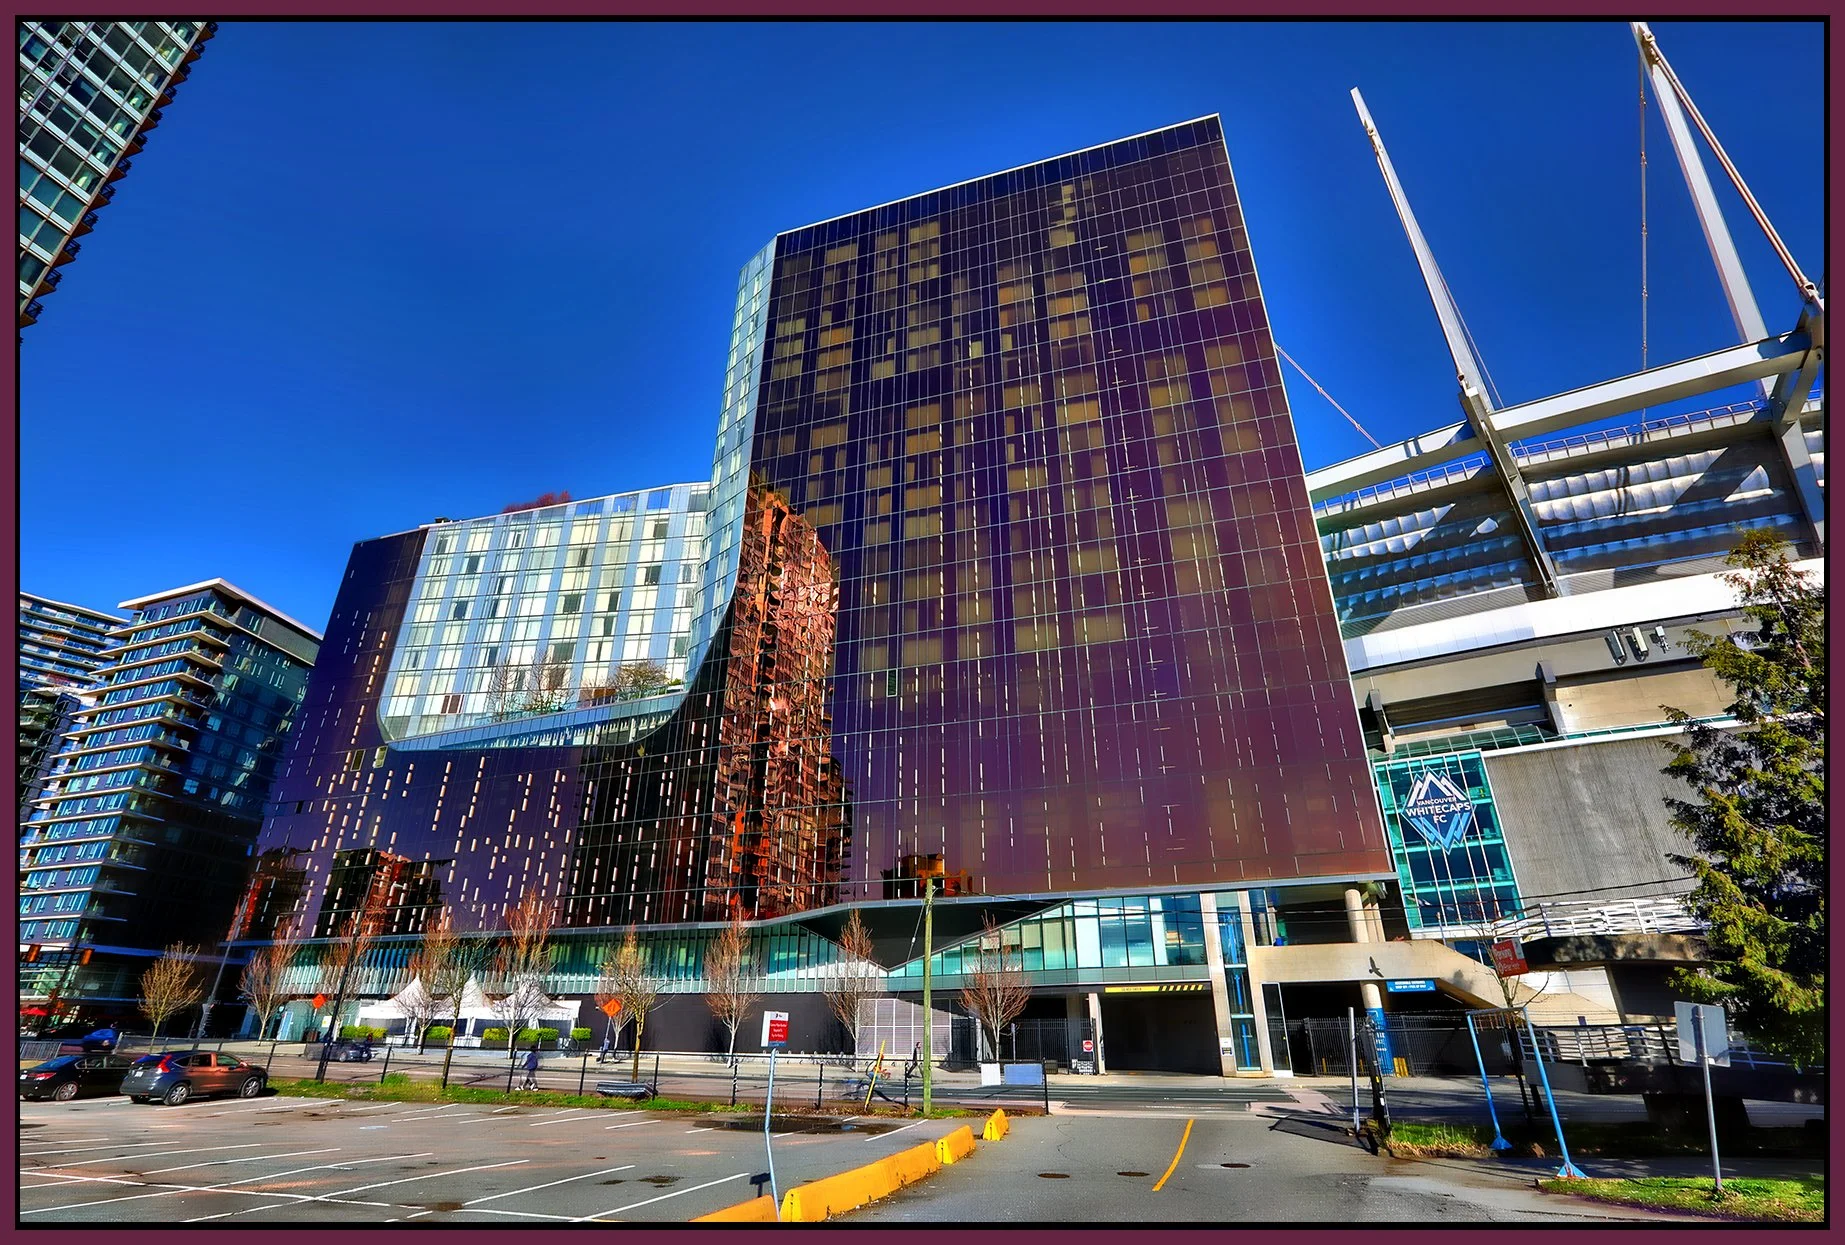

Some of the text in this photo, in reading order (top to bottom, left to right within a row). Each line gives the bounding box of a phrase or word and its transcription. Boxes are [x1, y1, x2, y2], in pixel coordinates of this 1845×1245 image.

[1416, 796, 1457, 806] VANCOUVER
[1405, 802, 1471, 817] WHITECAPS
[1433, 814, 1448, 824] FC
